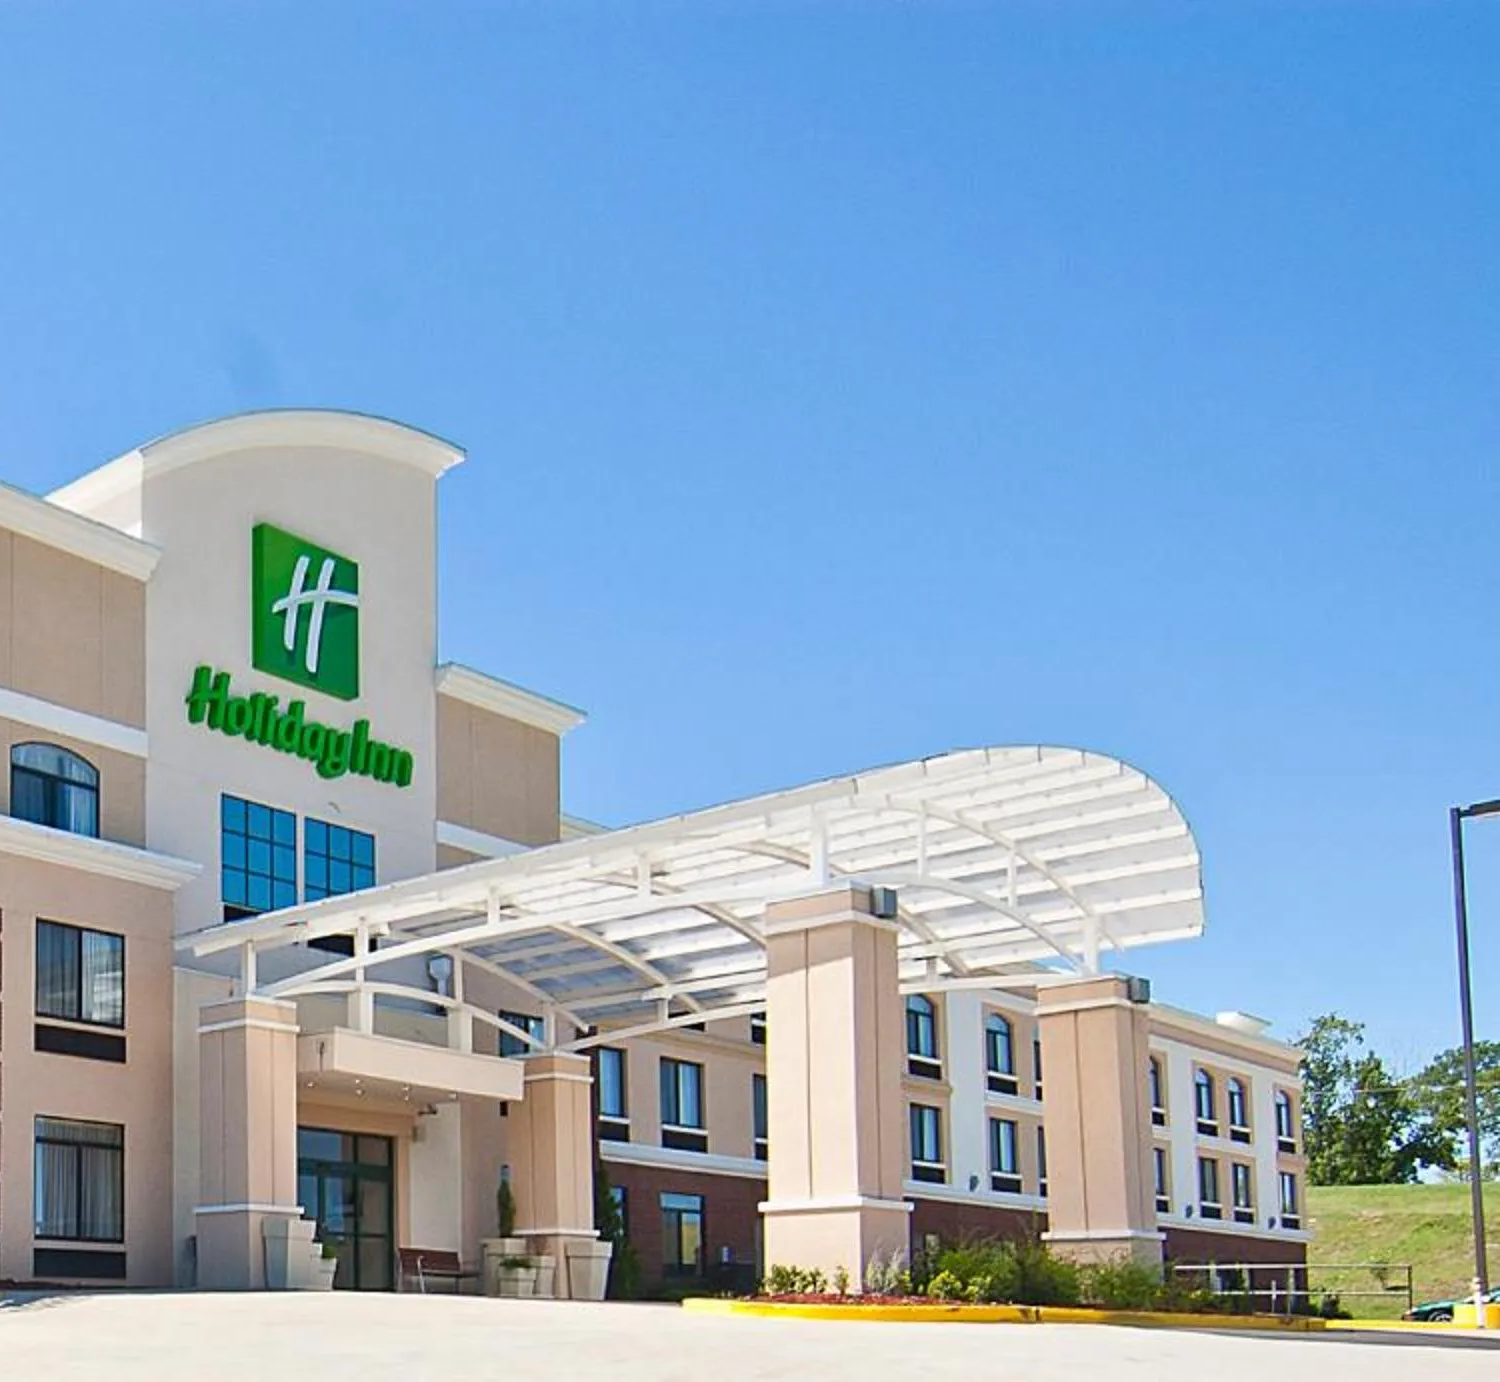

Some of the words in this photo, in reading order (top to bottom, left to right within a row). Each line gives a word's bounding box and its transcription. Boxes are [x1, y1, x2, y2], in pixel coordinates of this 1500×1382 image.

[271, 555, 358, 673] H
[185, 666, 352, 779] Holiday
[351, 719, 413, 787] Inn
